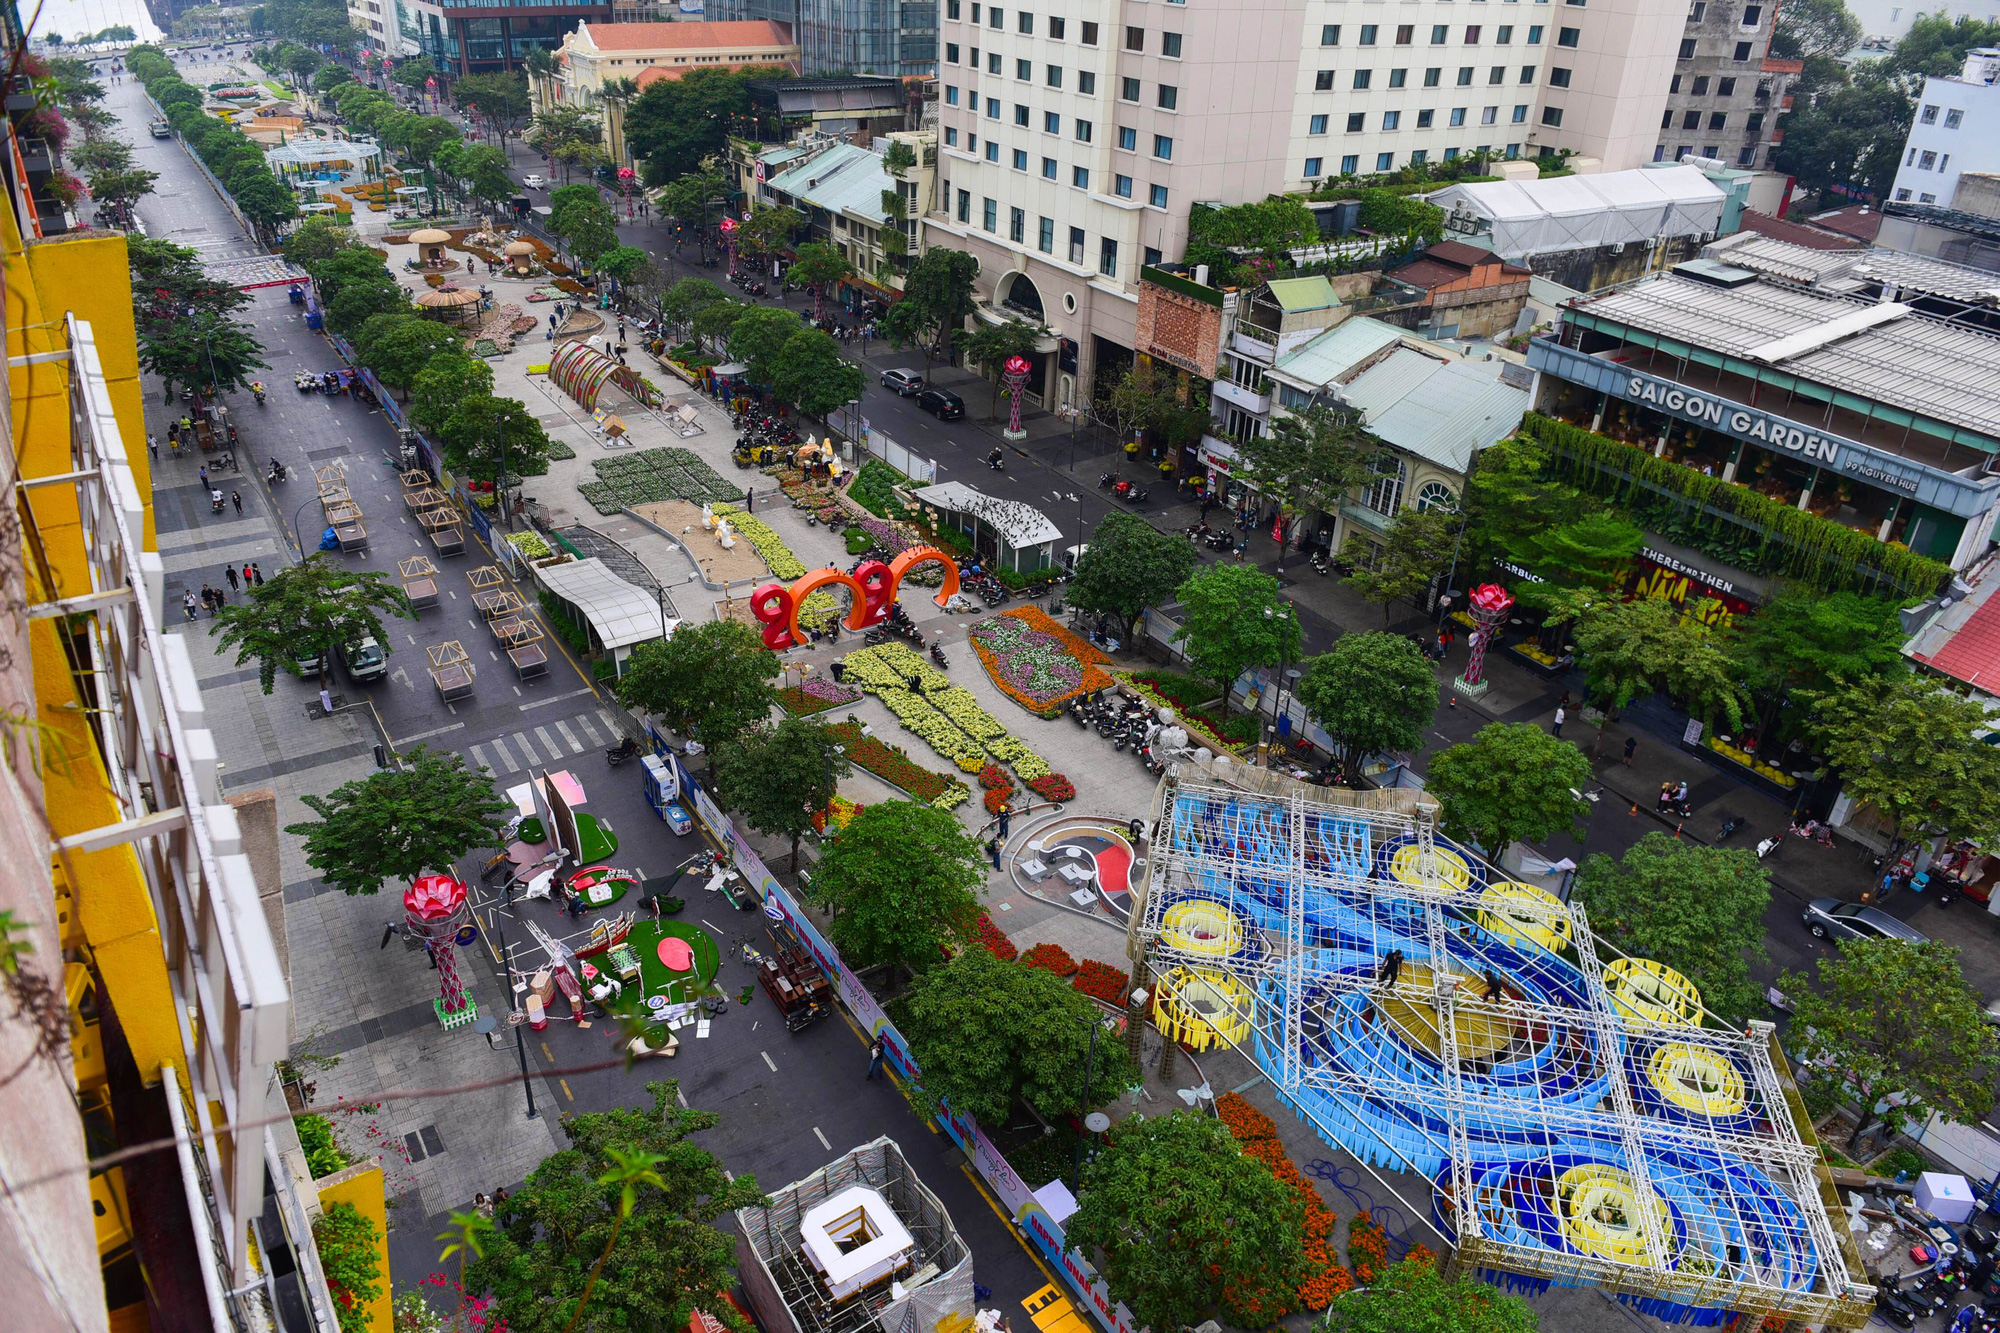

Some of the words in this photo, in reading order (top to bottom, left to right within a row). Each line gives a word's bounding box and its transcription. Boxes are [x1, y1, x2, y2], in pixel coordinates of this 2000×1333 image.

[1629, 377, 1722, 424] SAIGON
[1731, 412, 1839, 463] GARDEN
[1845, 461, 1858, 471] 99
[1858, 465, 1899, 486] NGUYEN
[1898, 478, 1917, 492] HUE
[1642, 547, 1680, 569] THERE
[1699, 571, 1733, 593] THEN
[1031, 1214, 1060, 1256] HAPPY
[1062, 1252, 1092, 1297] LUNAR
